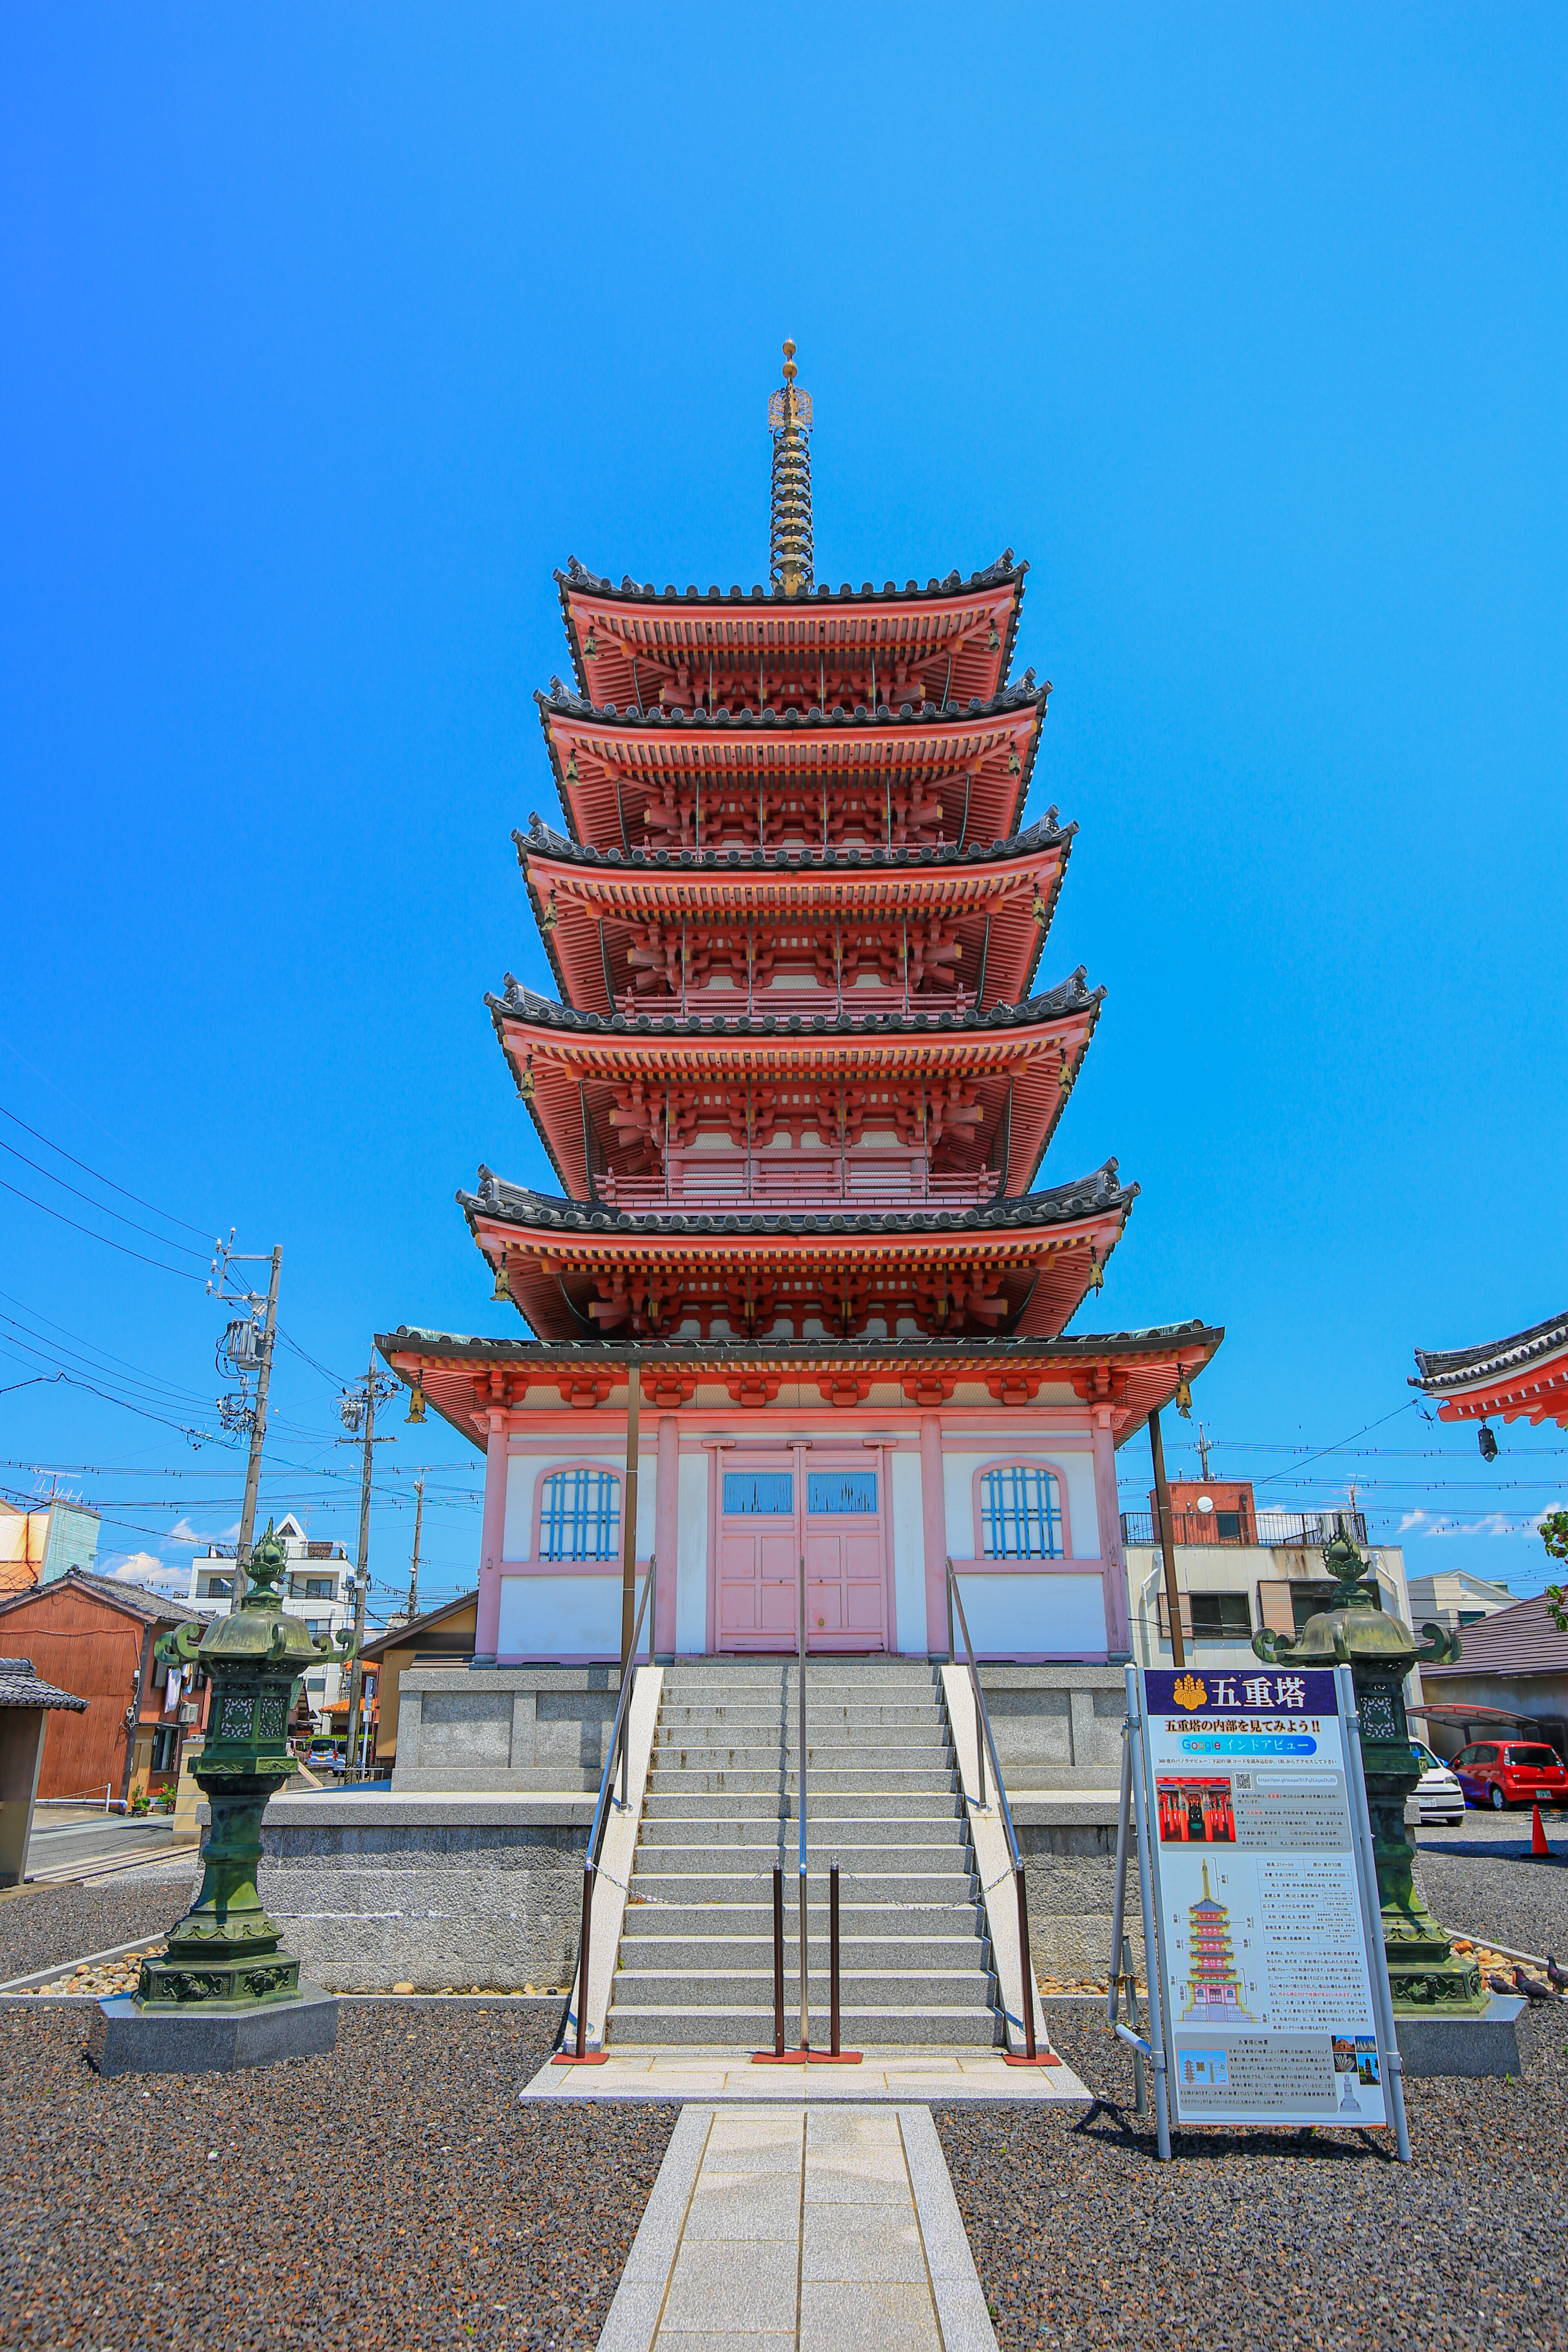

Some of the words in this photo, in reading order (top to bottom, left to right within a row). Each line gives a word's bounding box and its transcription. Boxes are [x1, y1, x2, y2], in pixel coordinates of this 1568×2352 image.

[1209, 1676, 1306, 1708] 五重塔
[1182, 1739, 1221, 1752] Google
[1225, 1739, 1308, 1751] インドアビュー
